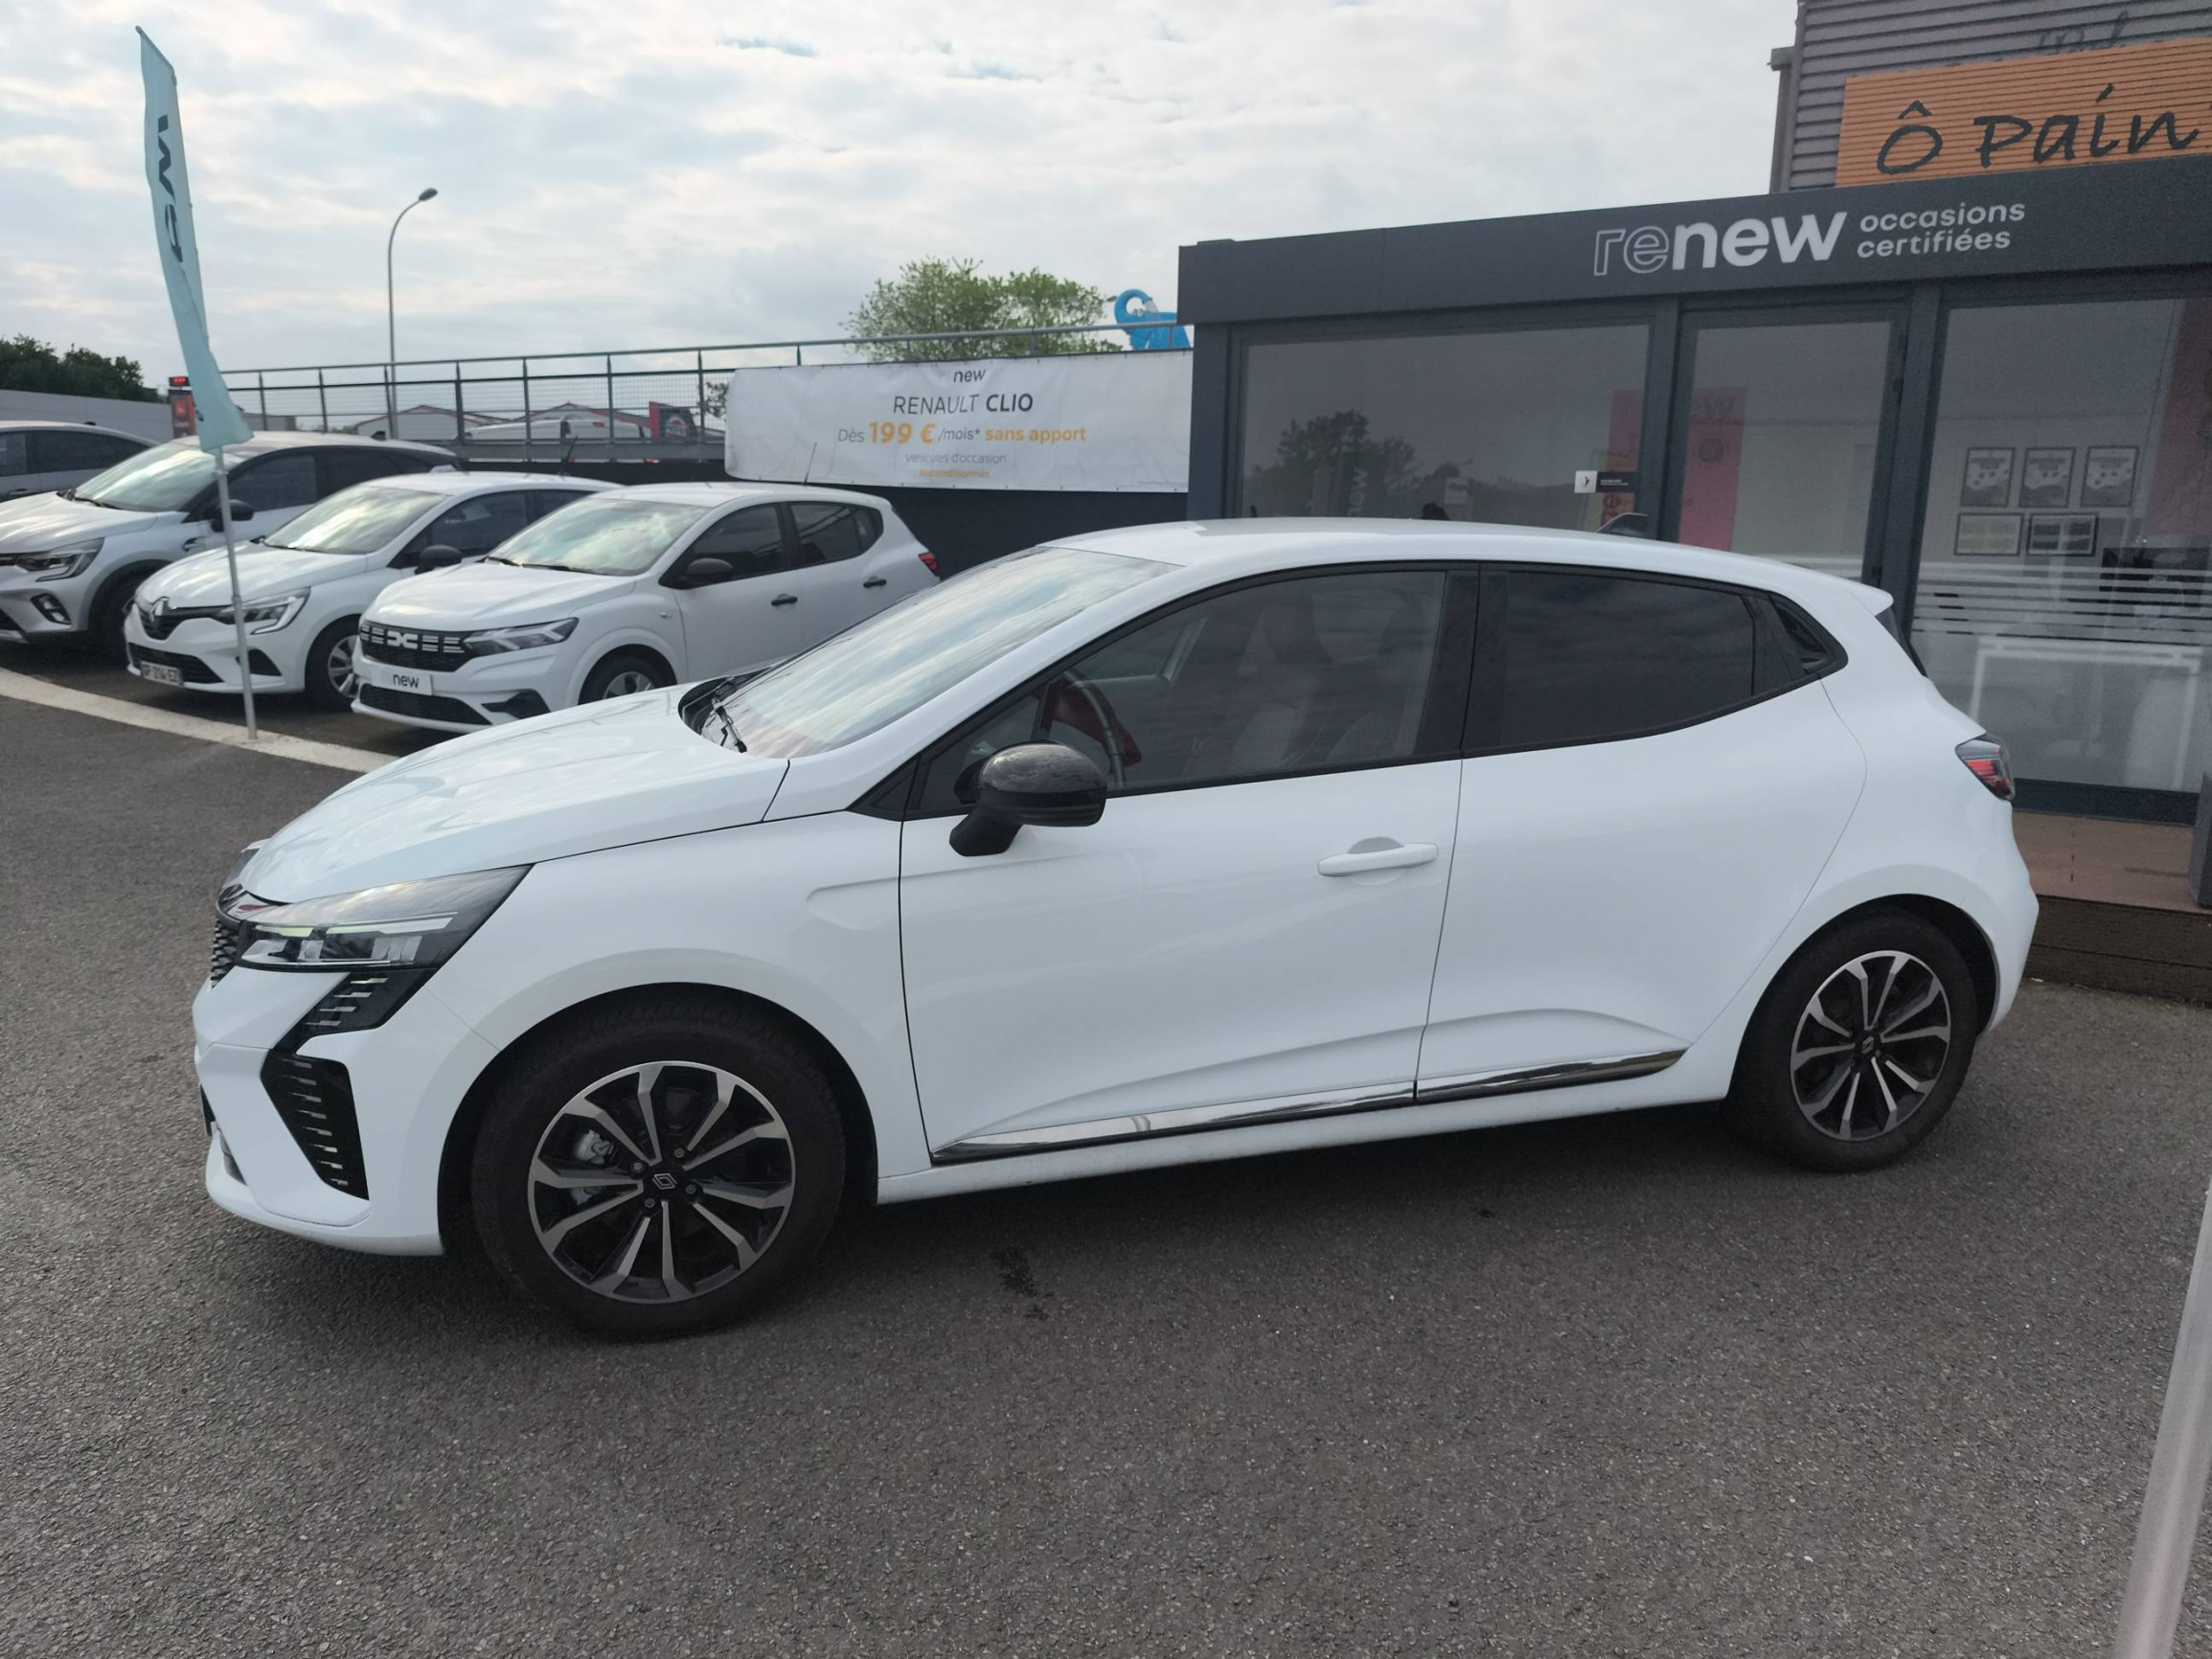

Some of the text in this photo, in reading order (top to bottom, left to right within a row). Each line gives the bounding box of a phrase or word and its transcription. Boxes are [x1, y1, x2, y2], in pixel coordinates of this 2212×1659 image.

[1877, 100, 1943, 174] Ô
[1859, 201, 2025, 233] occasions
[1593, 212, 1847, 276] renew
[1857, 227, 2011, 259] certifiées
[953, 370, 986, 383] new
[893, 393, 1034, 415] RENAULT CLIO
[837, 428, 865, 443] Dès
[869, 422, 913, 444] 199
[920, 423, 937, 444] €
[985, 428, 1024, 442] sans
[1029, 427, 1088, 445] apport
[393, 674, 420, 689] new
